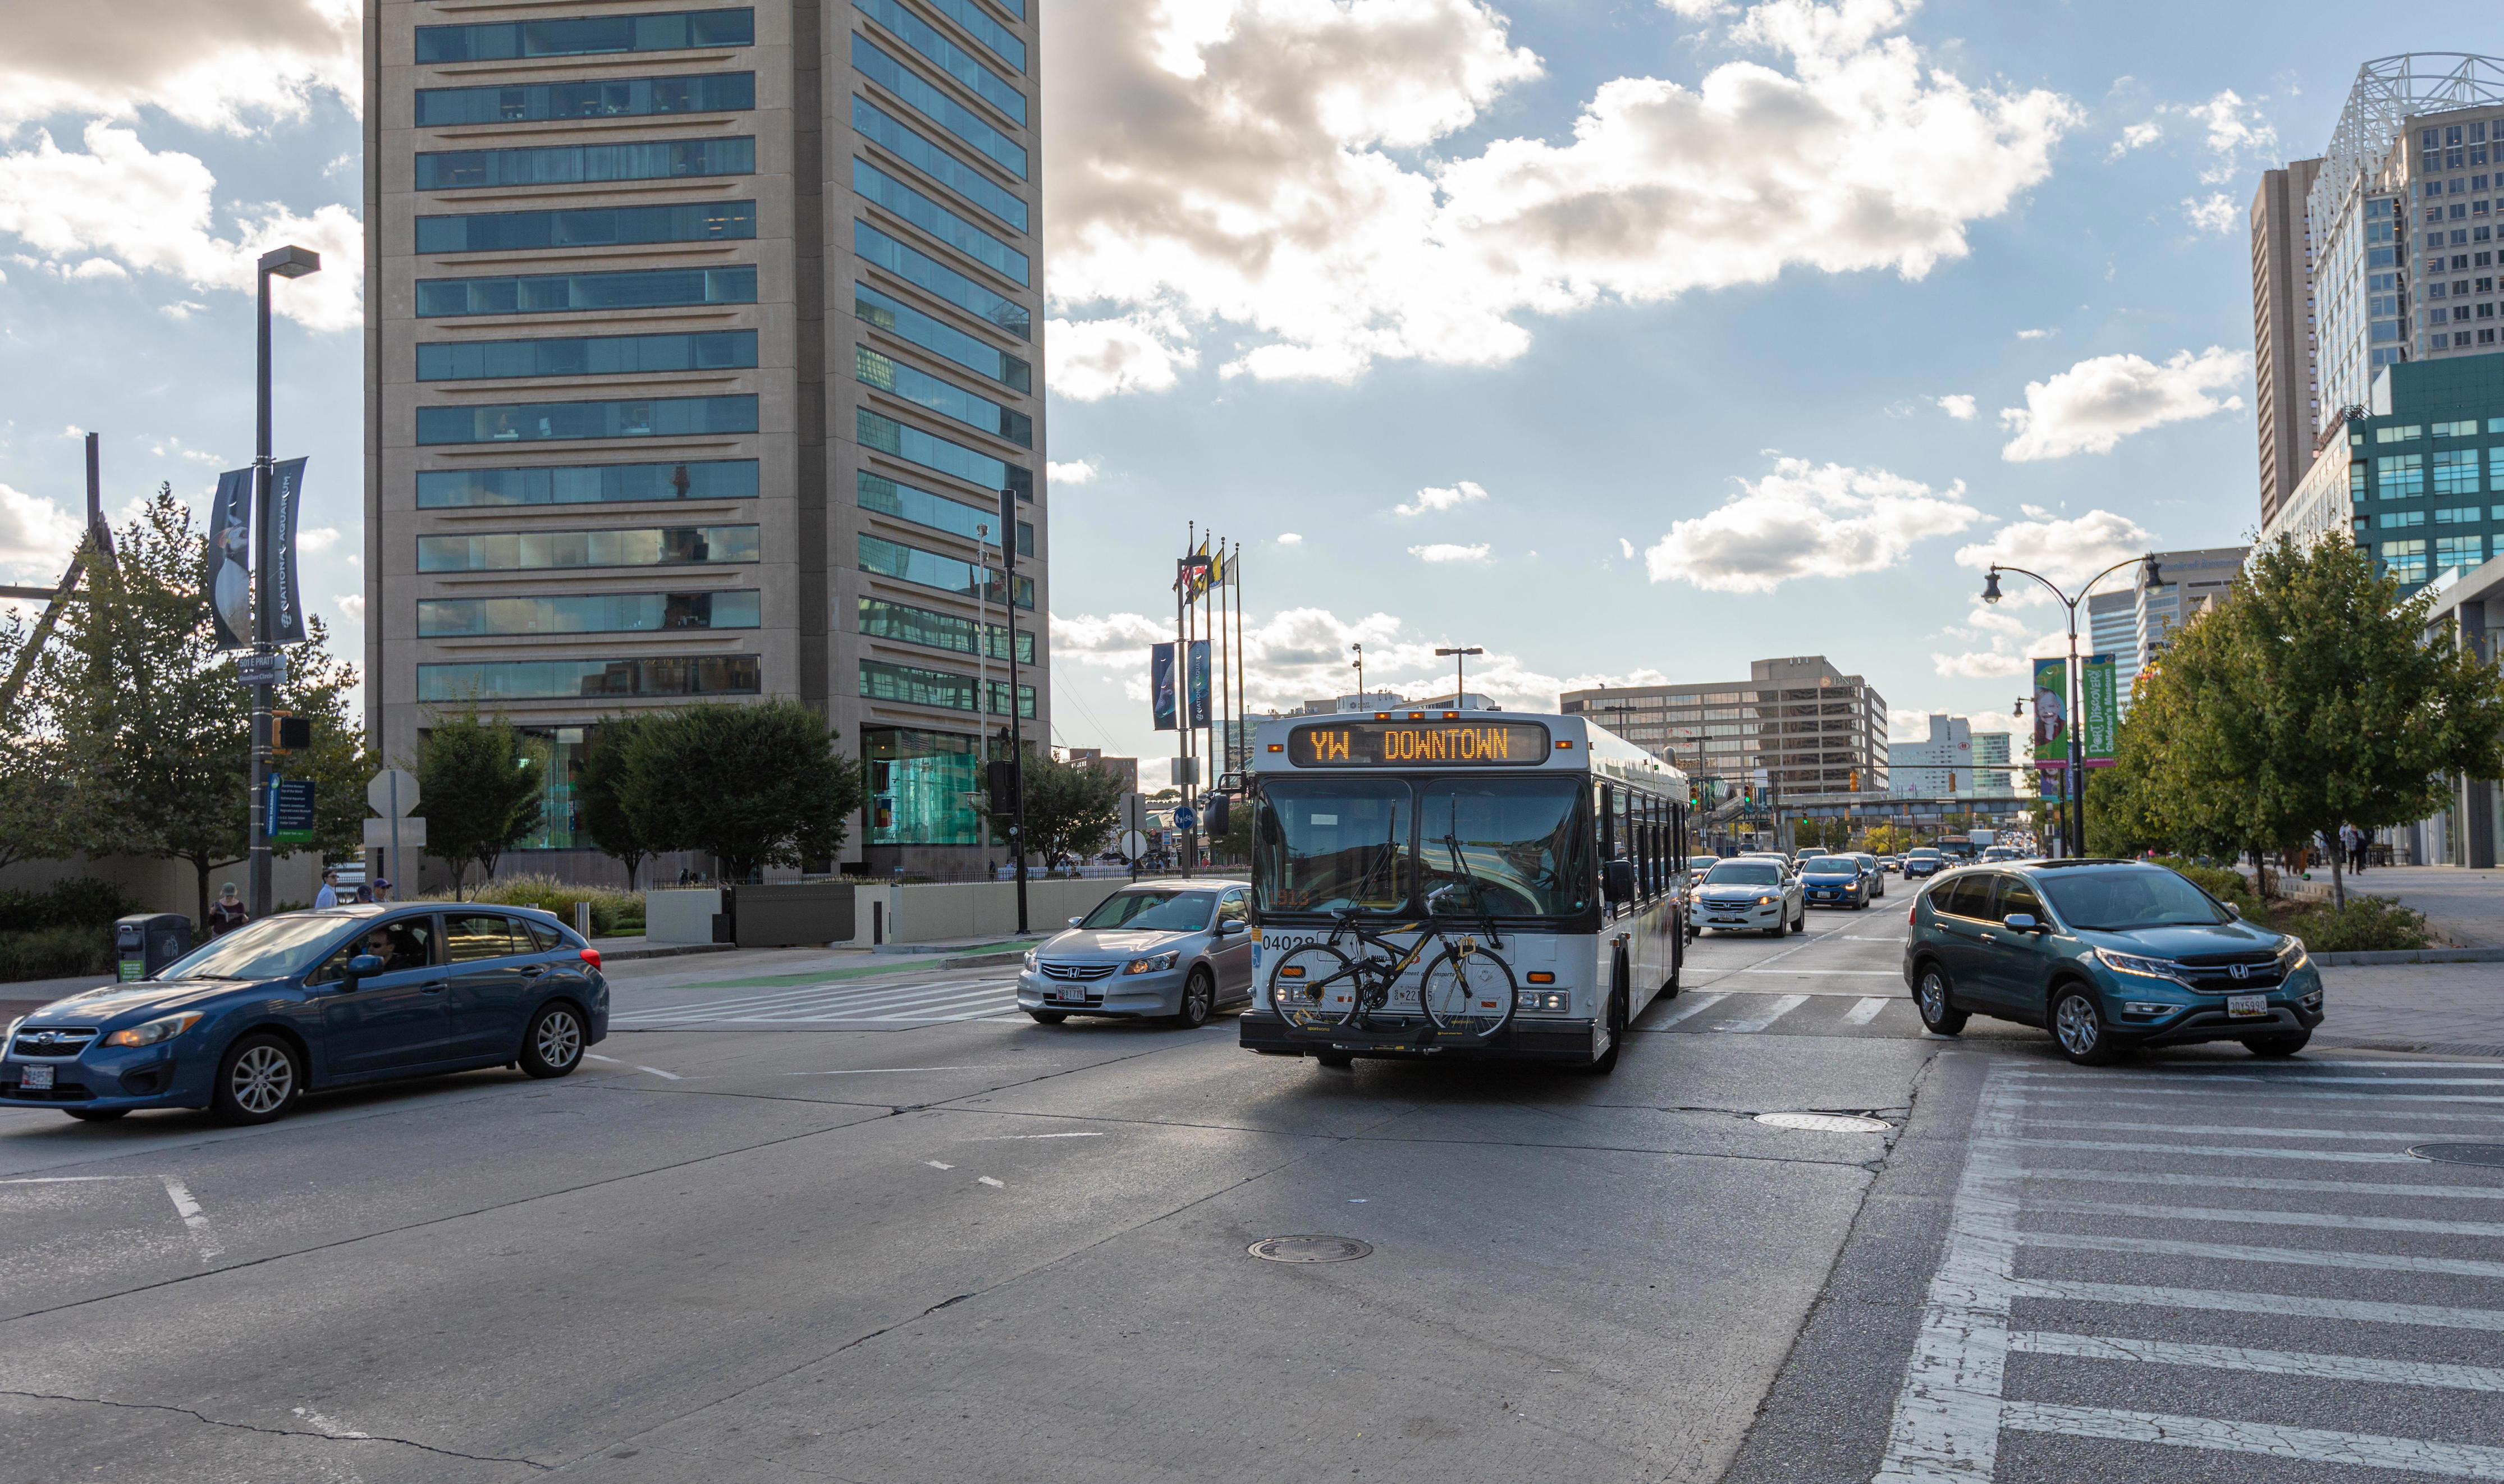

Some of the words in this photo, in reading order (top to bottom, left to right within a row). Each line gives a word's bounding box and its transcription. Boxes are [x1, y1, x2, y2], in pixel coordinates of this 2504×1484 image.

[240, 658, 250, 667] 501
[250, 658, 255, 666] E
[255, 656, 273, 666] PRATT
[2105, 707, 2114, 752] Children's
[1311, 731, 1349, 759] YW
[1385, 729, 1508, 759] DOWNTOWN
[1268, 889, 1310, 905] 1913
[1406, 990, 1432, 1001] 2215
